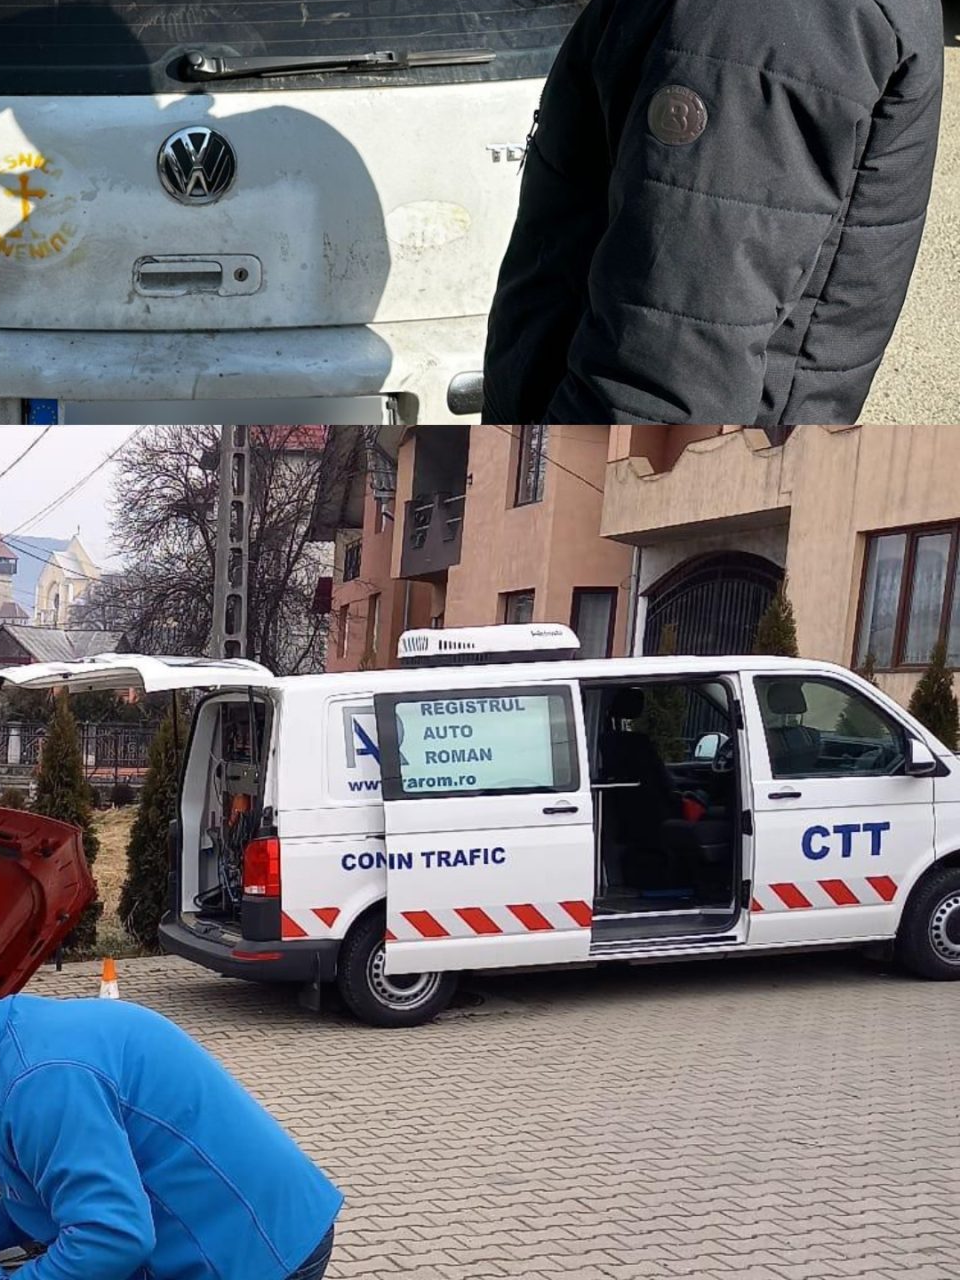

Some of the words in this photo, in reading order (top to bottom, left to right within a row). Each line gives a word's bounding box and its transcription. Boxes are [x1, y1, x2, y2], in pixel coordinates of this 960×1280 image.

[420, 698, 526, 717] REGISTRUL
[423, 724, 473, 740] AUTO
[425, 747, 493, 765] ROMAN
[801, 822, 891, 861] CTT
[420, 846, 506, 869] TRAFIC
